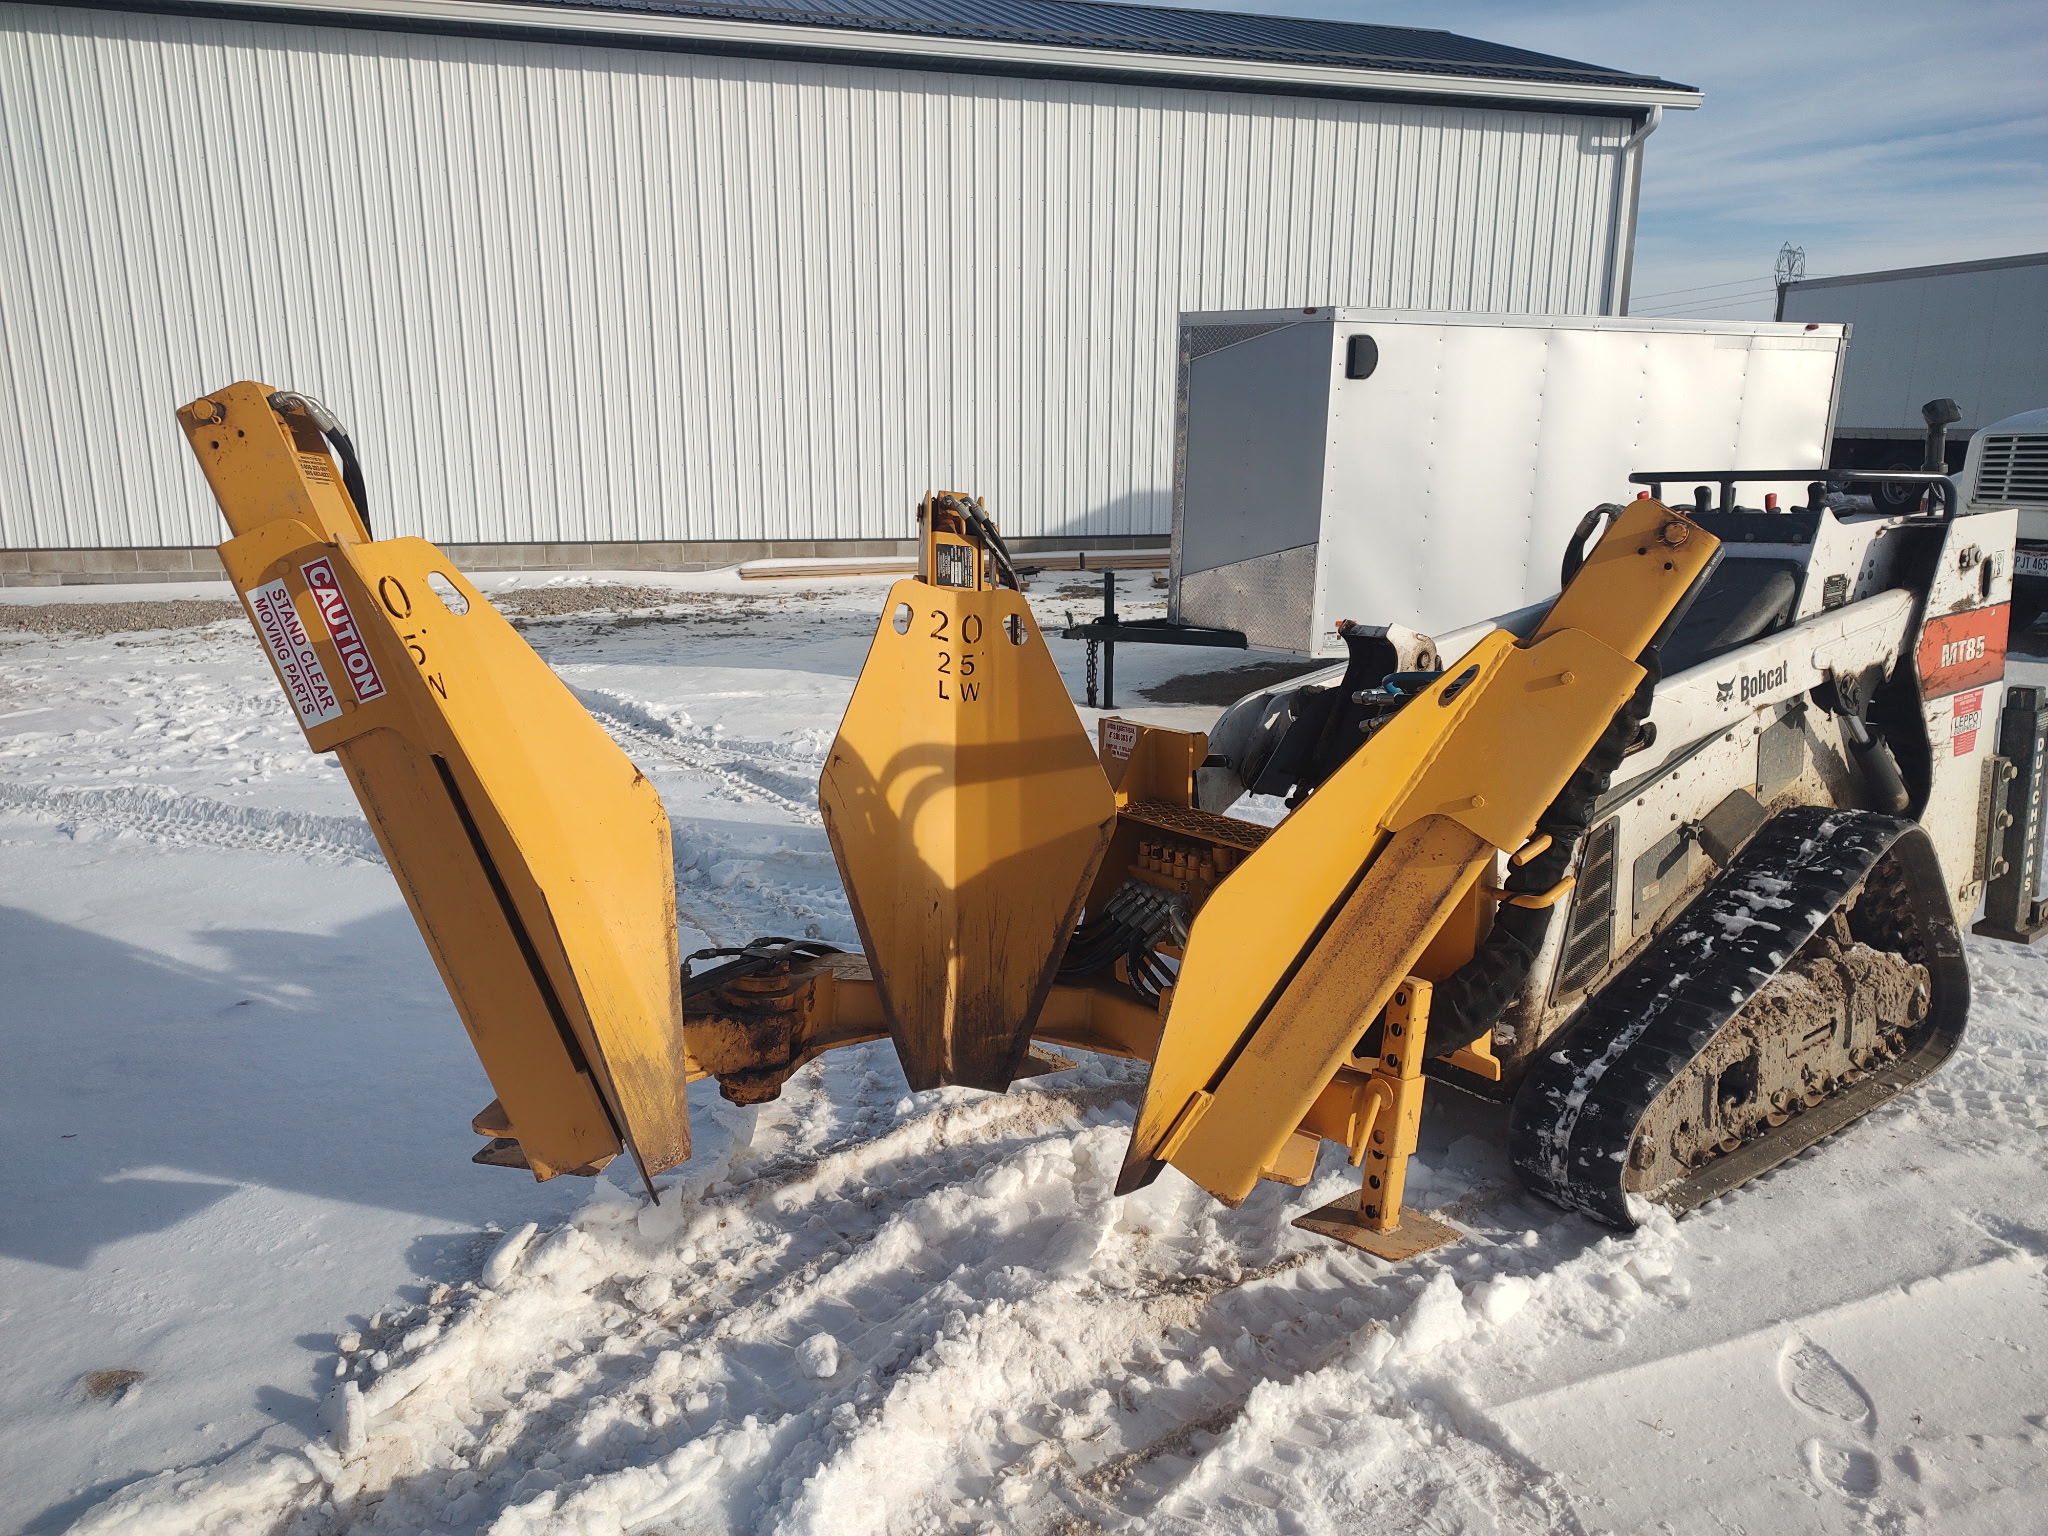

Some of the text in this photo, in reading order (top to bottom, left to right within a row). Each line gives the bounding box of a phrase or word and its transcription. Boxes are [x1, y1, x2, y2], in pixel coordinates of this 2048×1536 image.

[254, 597, 315, 715] MOVING PARTS
[272, 588, 335, 711] STAND CLEAR
[309, 566, 379, 696] CAUTION
[1740, 660, 1788, 702] Bobcat
[1941, 634, 1985, 669] MT85
[1954, 711, 1979, 729] LEPPO
[2024, 737, 2045, 892] DUTCHMANS
